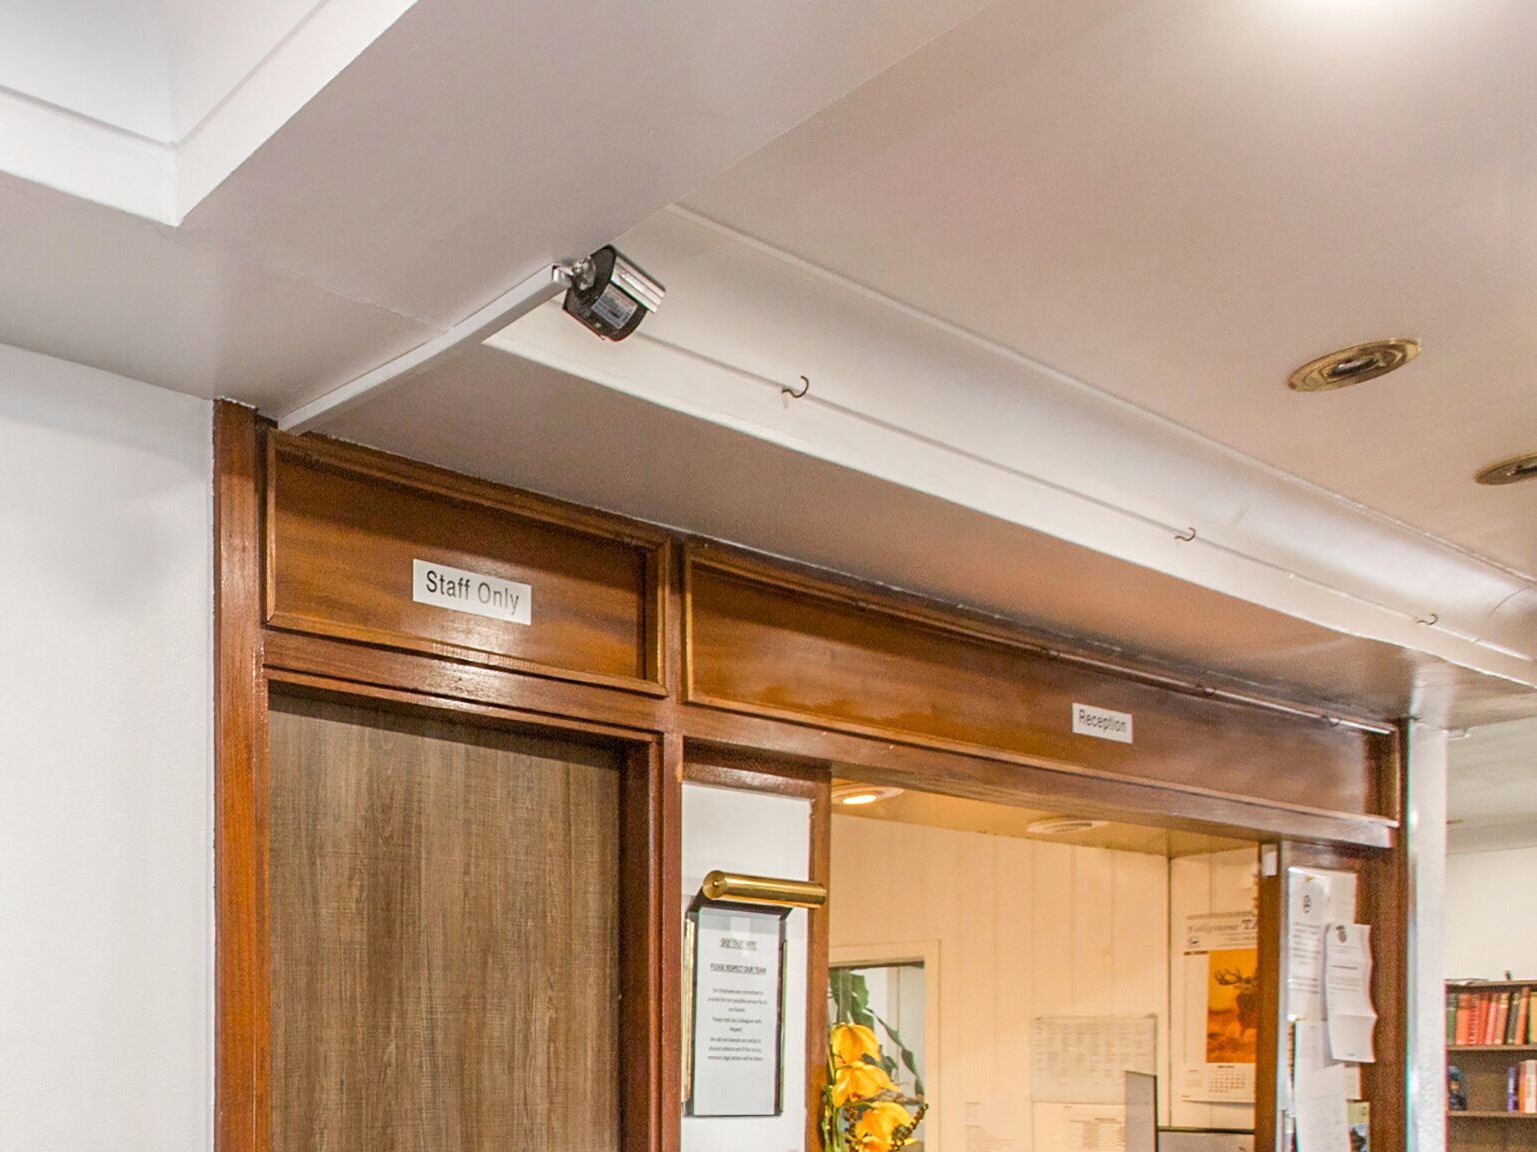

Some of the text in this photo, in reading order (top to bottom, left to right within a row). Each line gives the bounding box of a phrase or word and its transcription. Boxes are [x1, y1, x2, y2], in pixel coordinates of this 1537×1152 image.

[425, 570, 519, 615] Staff Only
[1079, 708, 1127, 733] Reception
